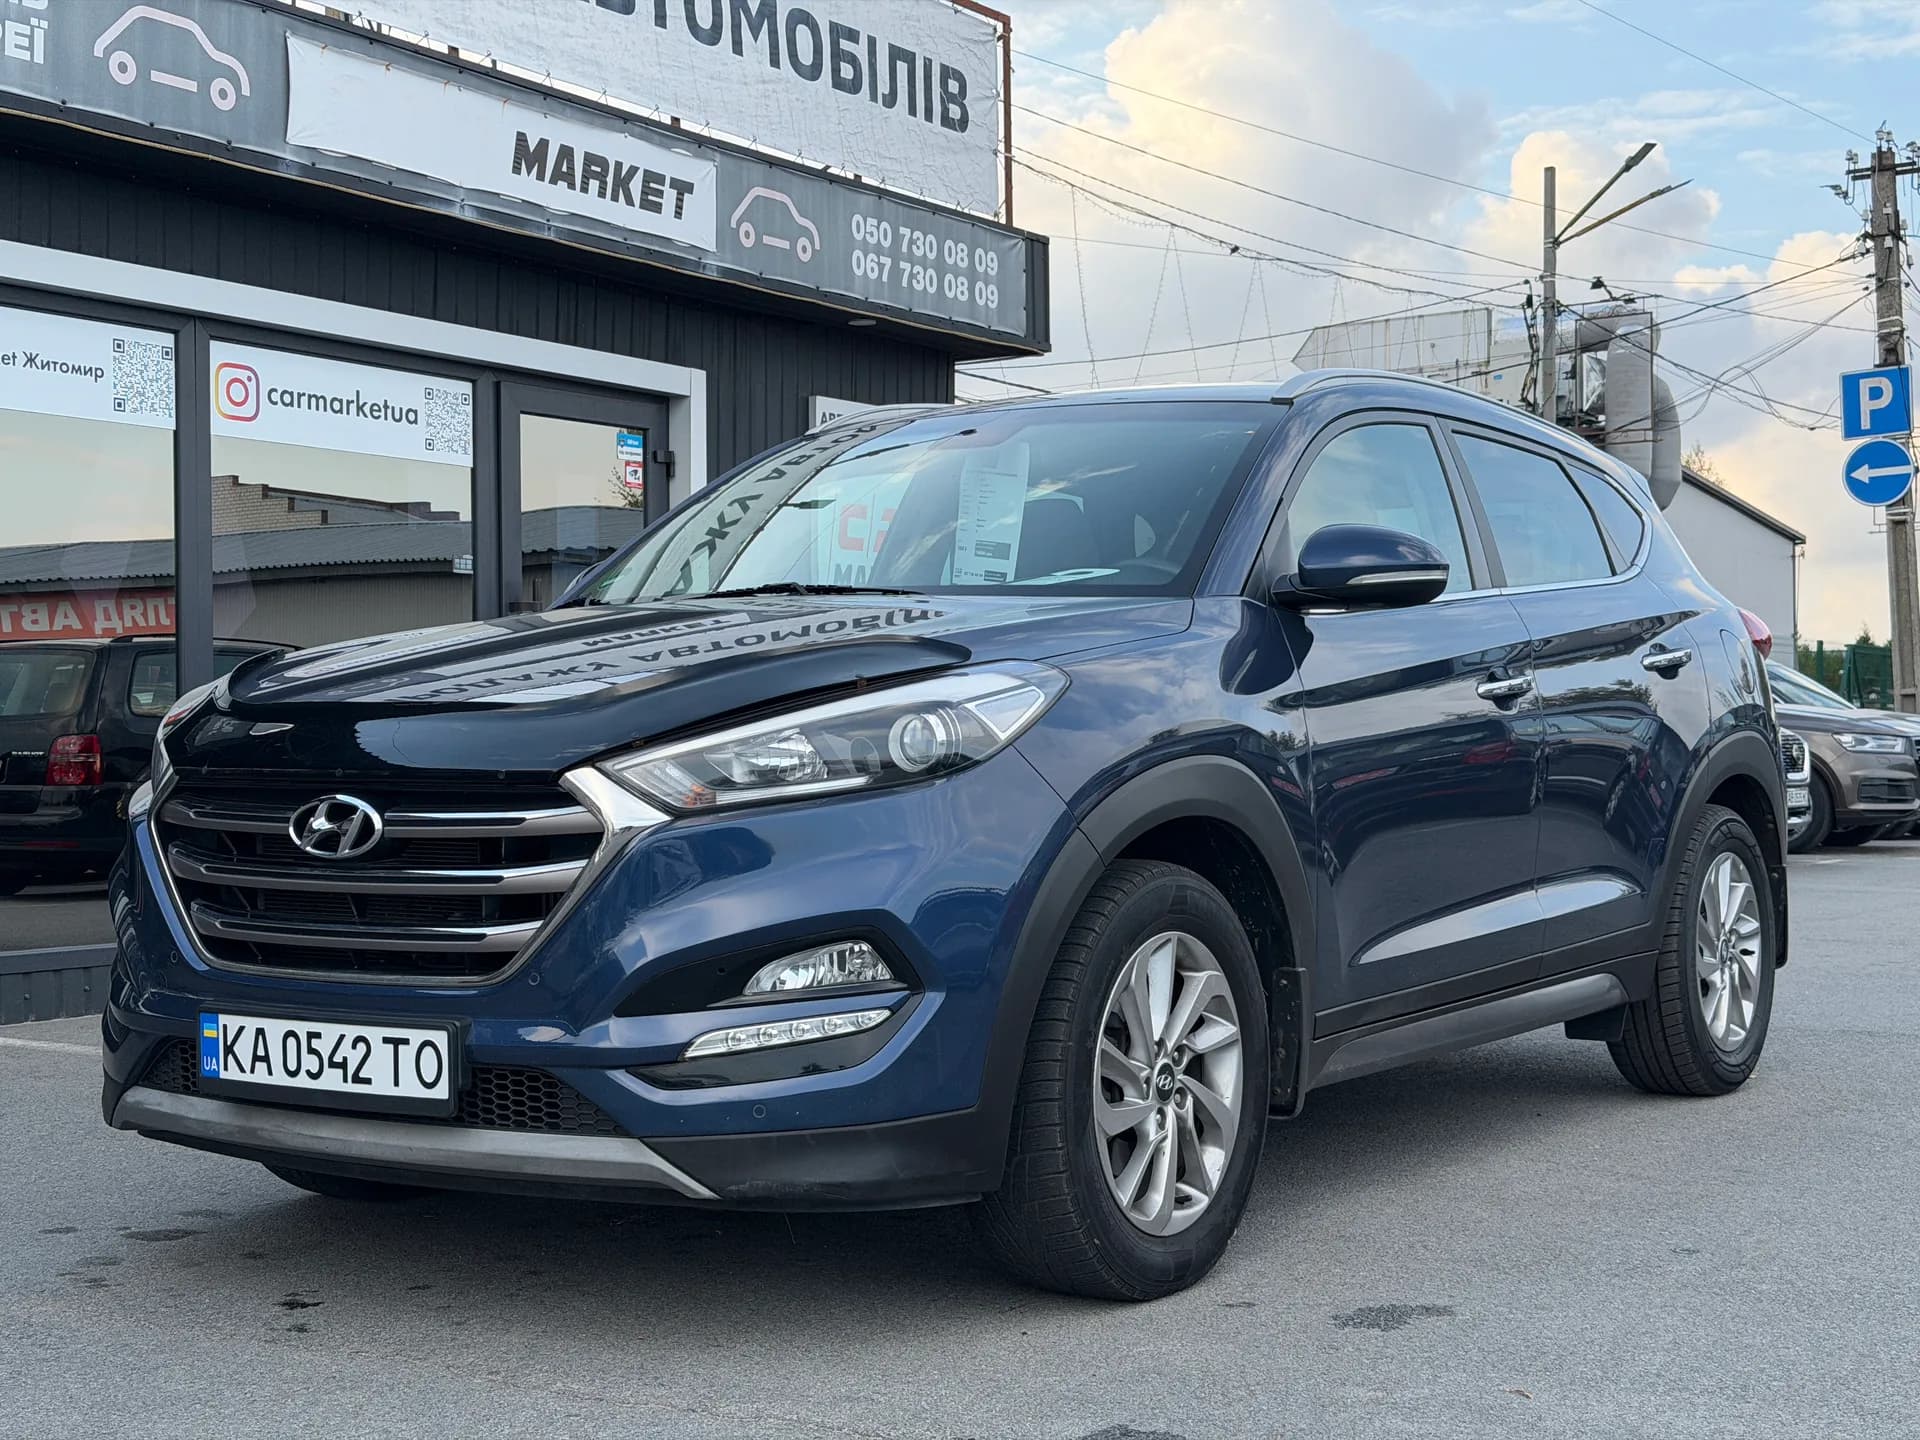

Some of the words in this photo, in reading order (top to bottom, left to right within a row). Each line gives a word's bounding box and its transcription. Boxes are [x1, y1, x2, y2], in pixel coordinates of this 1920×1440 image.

[0, 17, 49, 65] ЕЇ
[577, 0, 971, 134] ОМОБІЛІВ
[511, 130, 695, 220] MARKET
[851, 213, 893, 248] 050
[899, 225, 938, 260] 730
[943, 239, 969, 269] 08
[974, 247, 999, 276] 09
[851, 249, 892, 282] 067
[899, 260, 938, 294] 730
[943, 272, 969, 302] 08
[974, 280, 999, 309] 09
[0, 351, 18, 367] et
[22, 351, 105, 383] Житомир
[266, 389, 419, 425] carmarketua
[1859, 376, 1894, 430] P
[203, 1055, 219, 1072] UA
[222, 1023, 274, 1077] KA
[281, 1029, 373, 1086] 0542
[382, 1036, 444, 1090] TO
